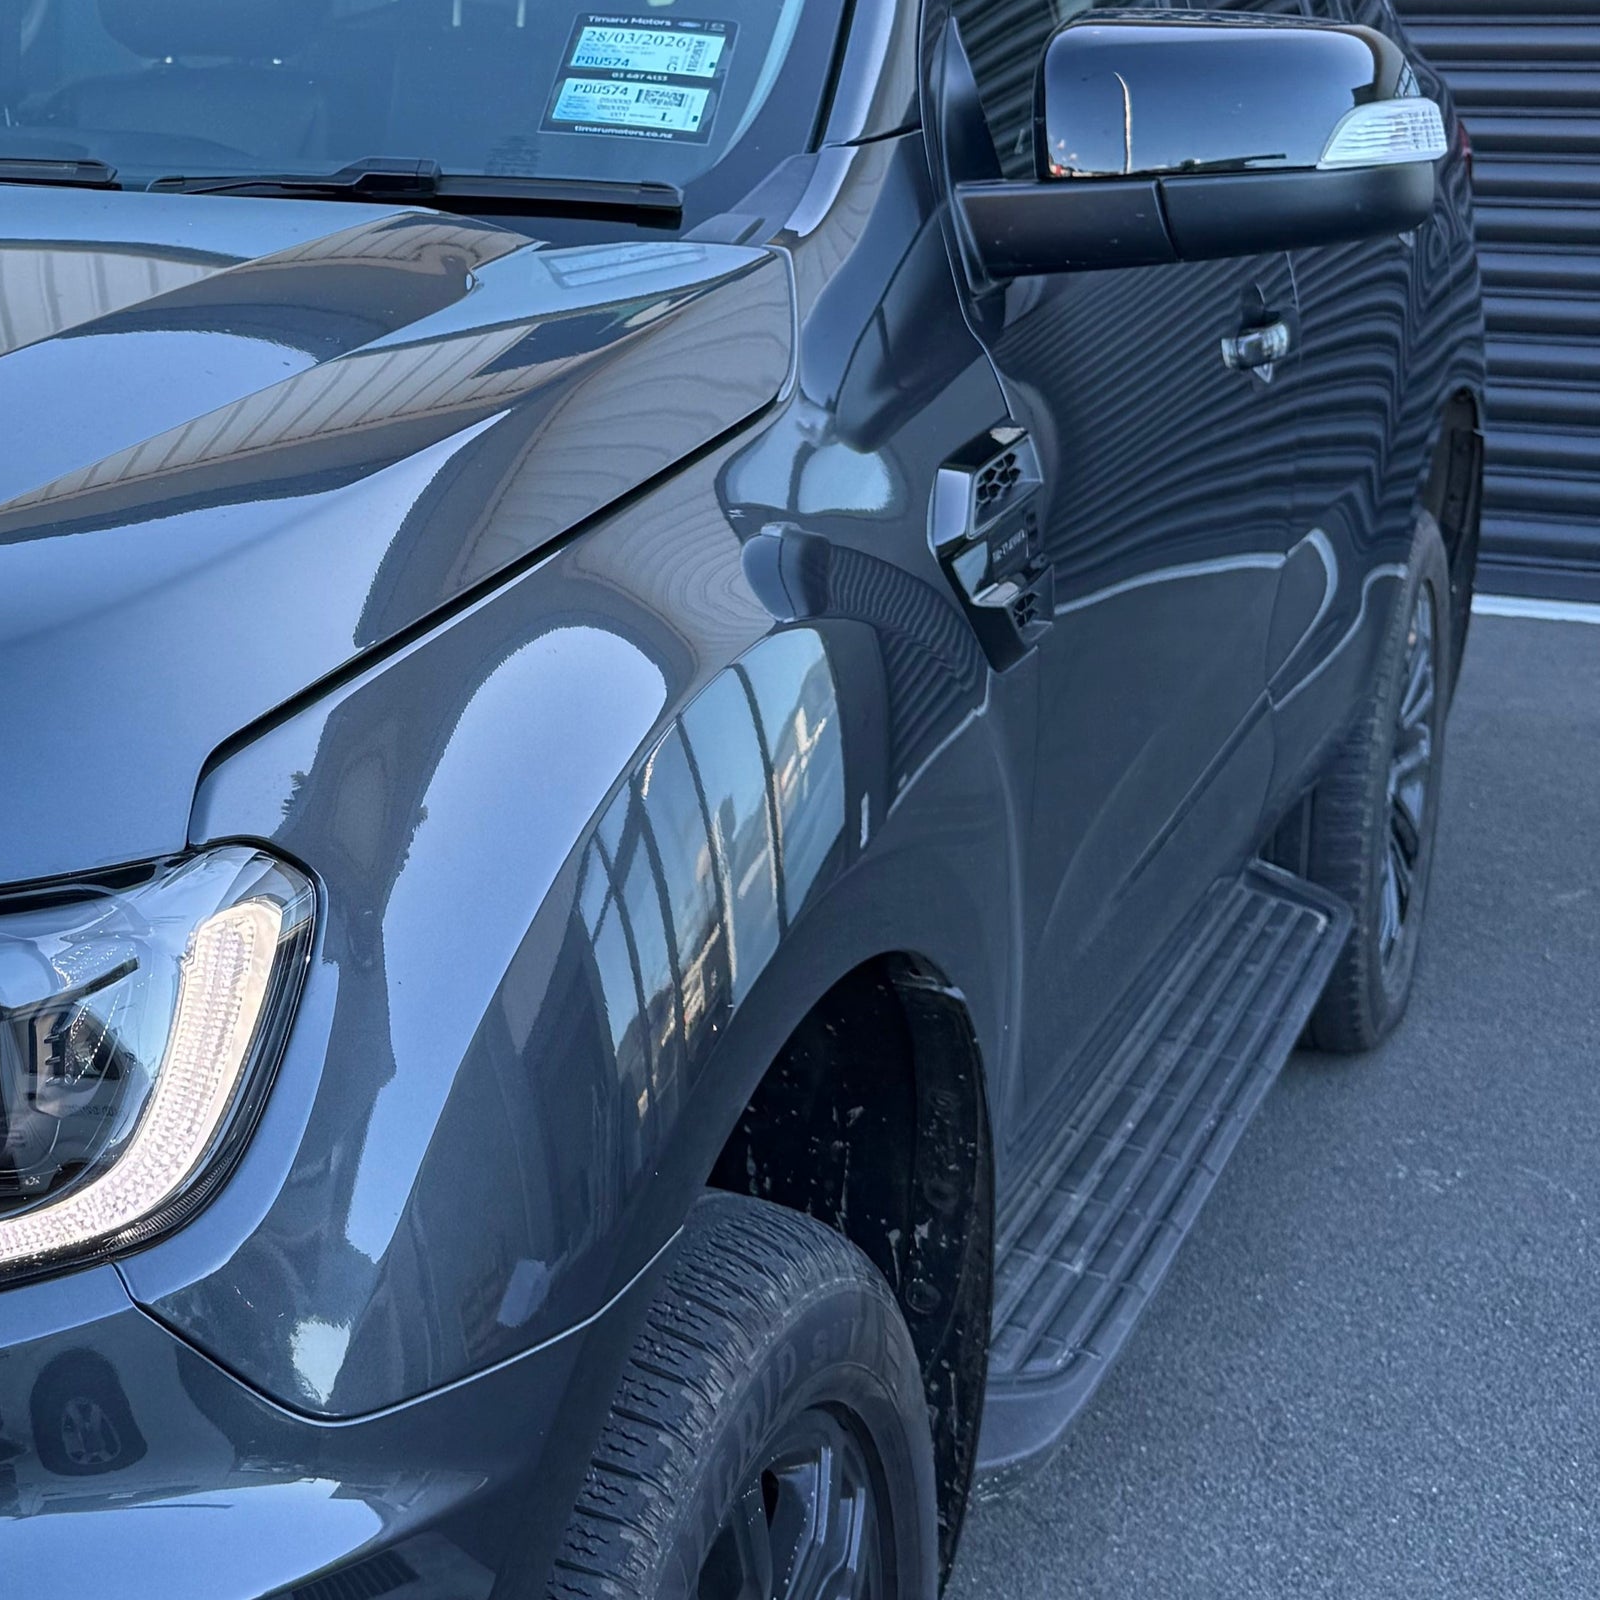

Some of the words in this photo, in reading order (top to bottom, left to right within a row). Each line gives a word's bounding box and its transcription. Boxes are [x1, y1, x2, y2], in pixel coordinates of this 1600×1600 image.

[588, 15, 629, 24] Timaru
[631, 17, 672, 27] Motors
[584, 30, 687, 48] 28/03/2026
[575, 55, 630, 68] PDU574
[573, 84, 629, 96] PDU574
[574, 125, 673, 139] timarumotors.co.nz
